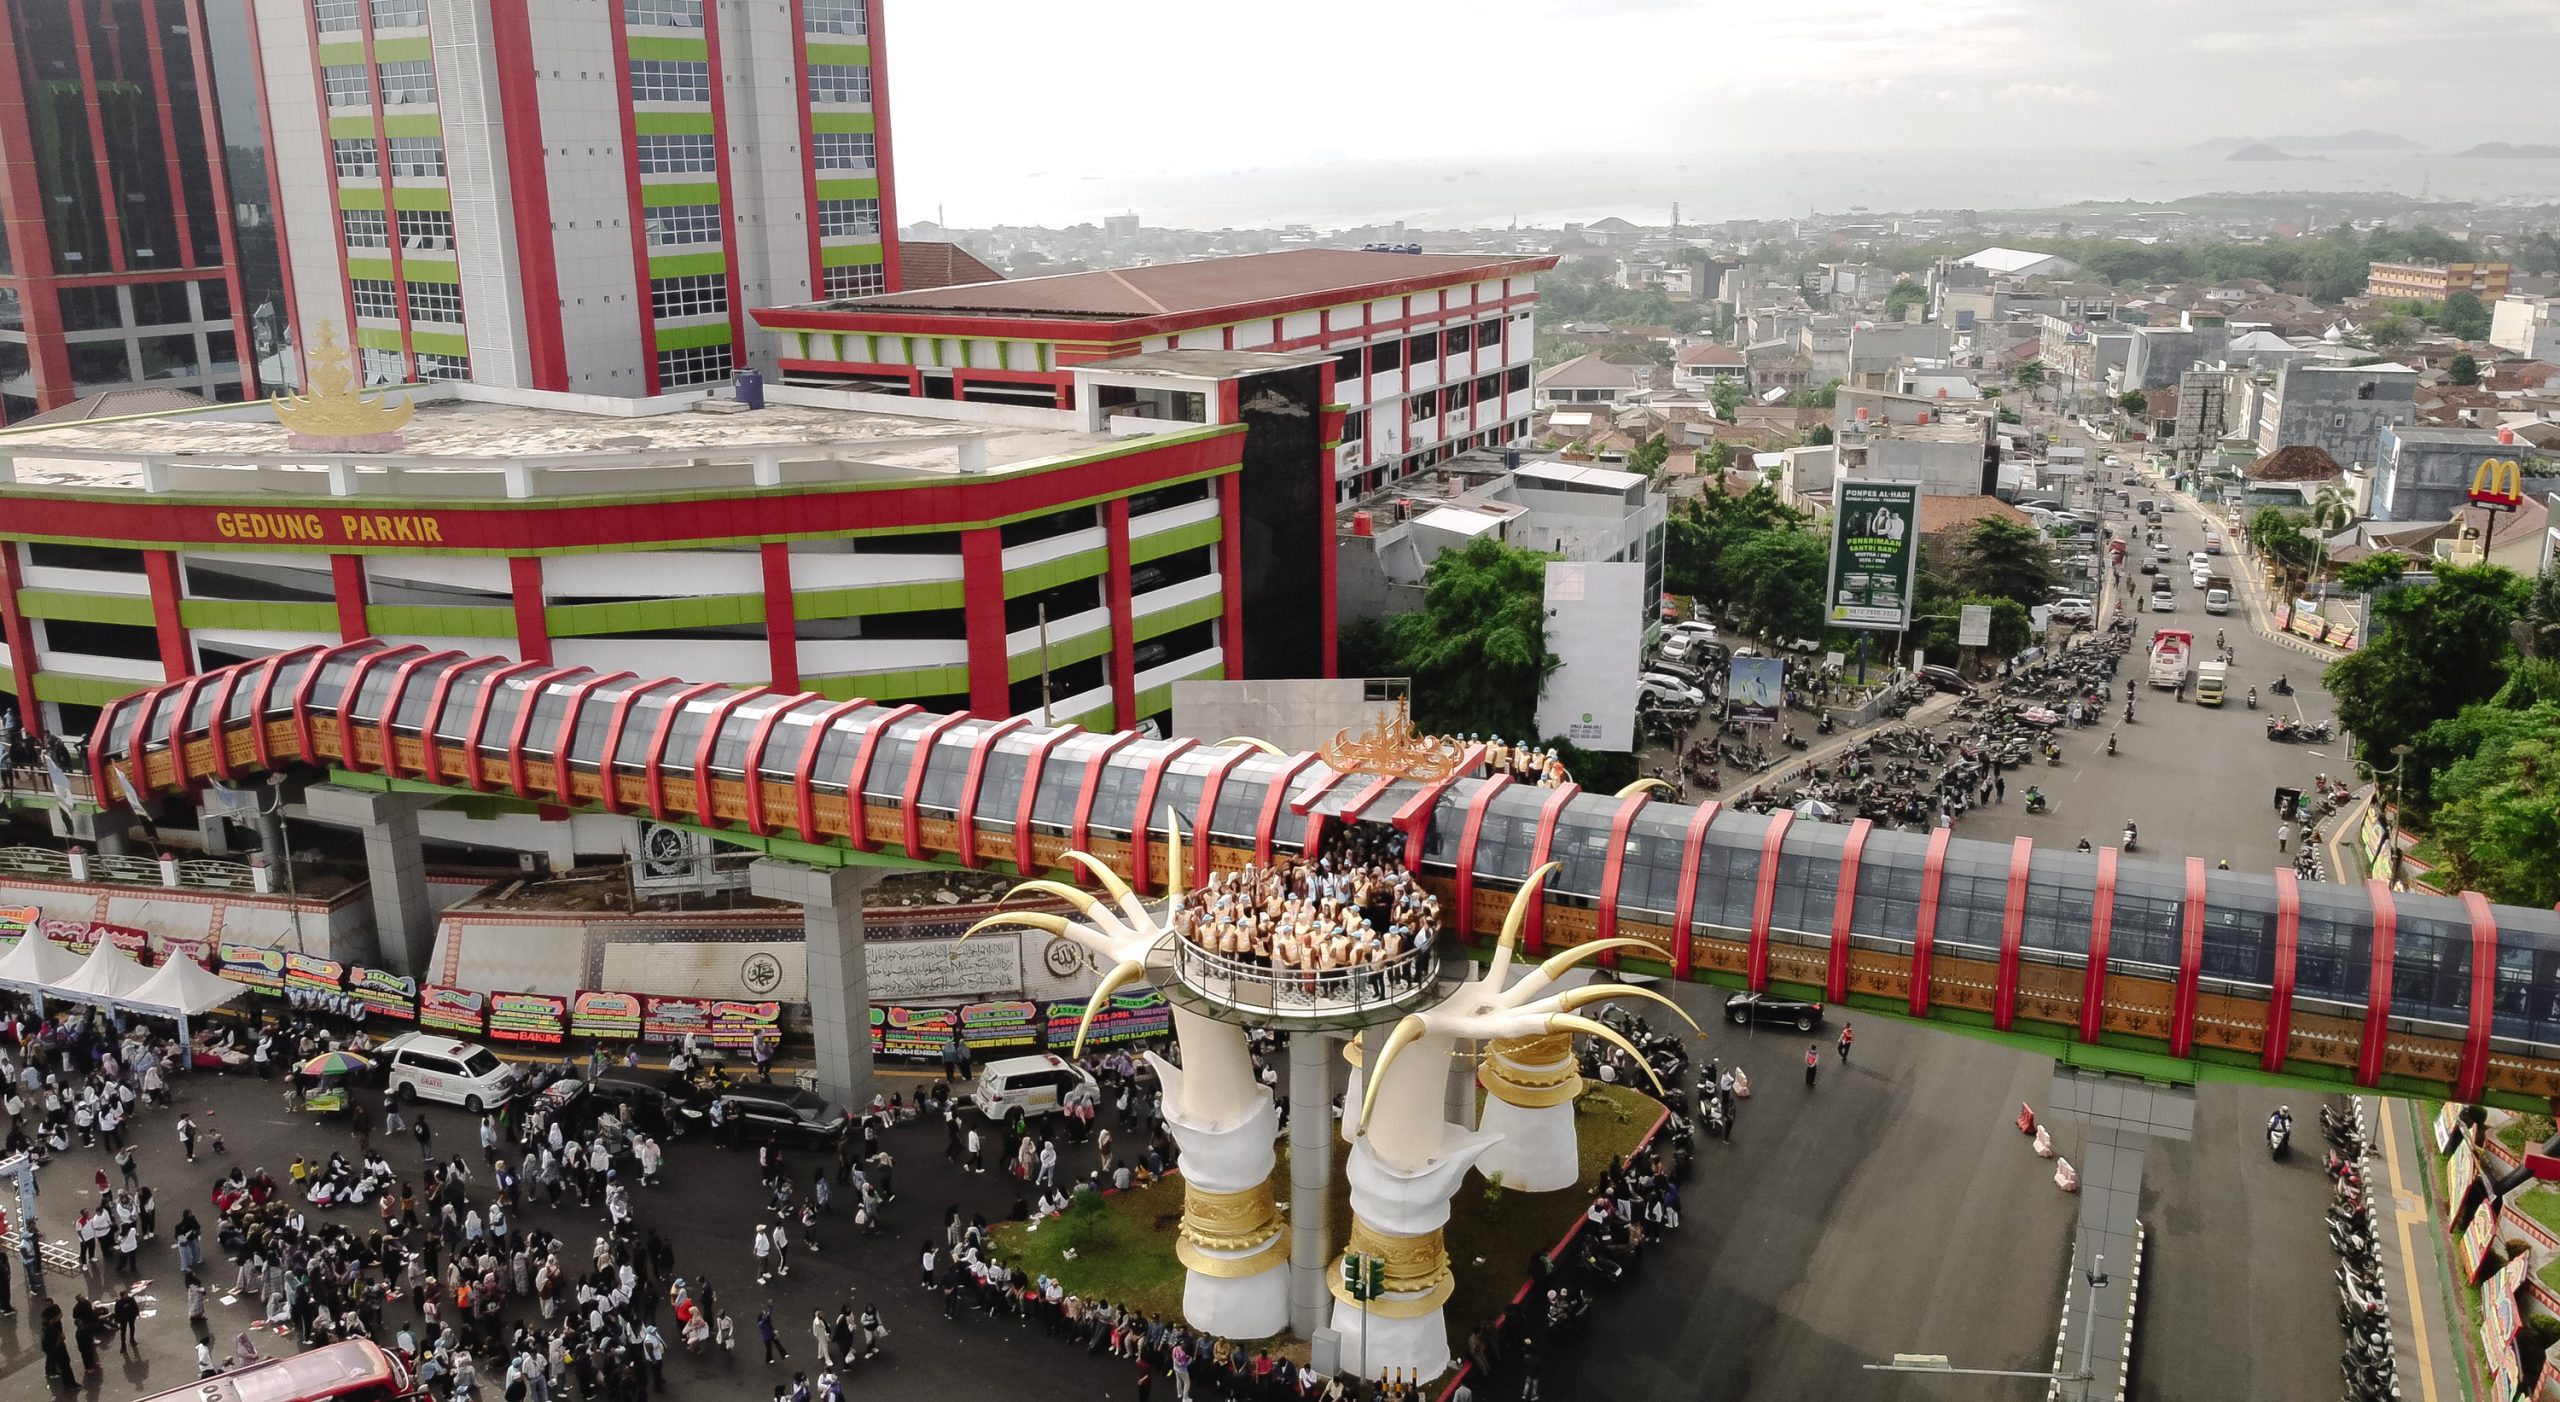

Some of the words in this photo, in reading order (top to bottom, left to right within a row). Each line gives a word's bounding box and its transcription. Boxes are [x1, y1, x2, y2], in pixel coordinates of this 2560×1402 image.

[216, 512, 324, 540] GEDUNG
[342, 515, 443, 542] PARKIR
[1847, 538, 1901, 546] PENERIMAAN
[502, 1003, 553, 1013] SELAMAT
[910, 1011, 945, 1020] SELAMAT
[520, 1031, 561, 1043] BAKUNG
